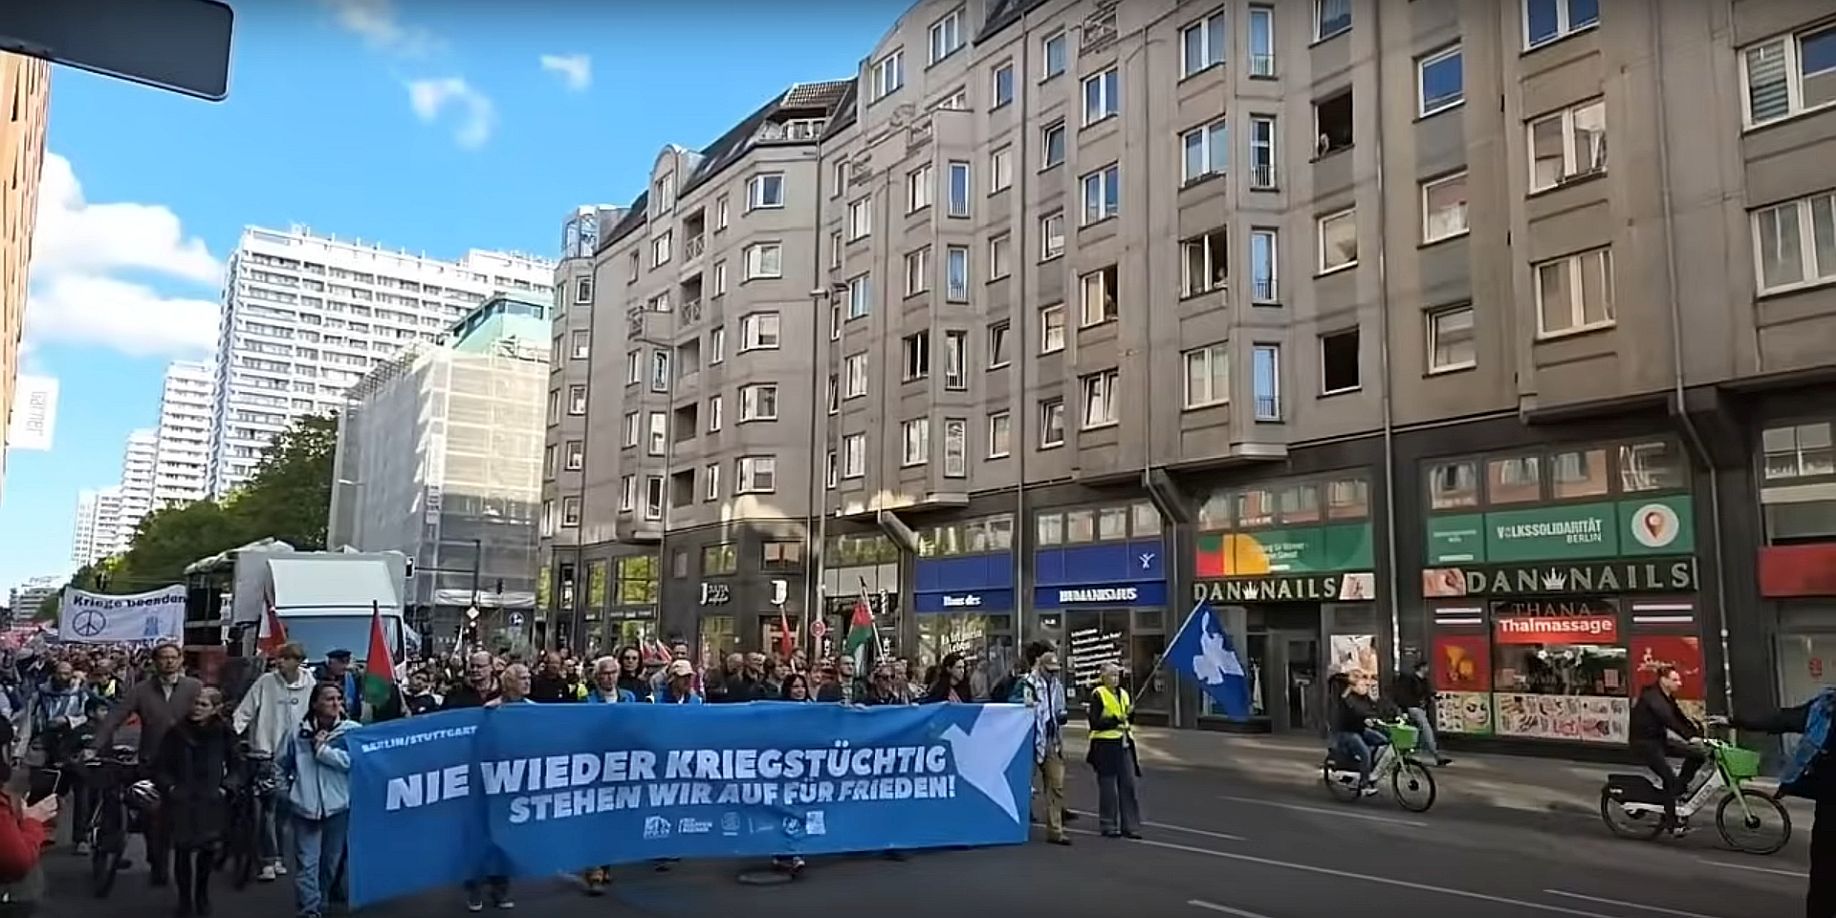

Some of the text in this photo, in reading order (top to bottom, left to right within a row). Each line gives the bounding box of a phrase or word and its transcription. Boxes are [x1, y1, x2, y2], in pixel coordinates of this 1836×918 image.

[1497, 517, 1602, 539] VOLKSSOLIDARITÄT
[1566, 533, 1602, 544] BERLIN
[1194, 577, 1337, 600] DAN NAILS
[1466, 562, 1690, 594] DAN NAILS
[73, 595, 123, 610] Kriege
[1059, 587, 1138, 603] HUMANISMUS
[1512, 601, 1593, 617] THANA
[1499, 617, 1614, 635] Thaimassage
[361, 725, 478, 753] BERLIN/STUTTGART
[386, 739, 947, 811] NIE WIEDER KRIEGSTÜCHTIG
[509, 774, 956, 824] STEHEN WIR AUF FÜR FRIEDEN!
